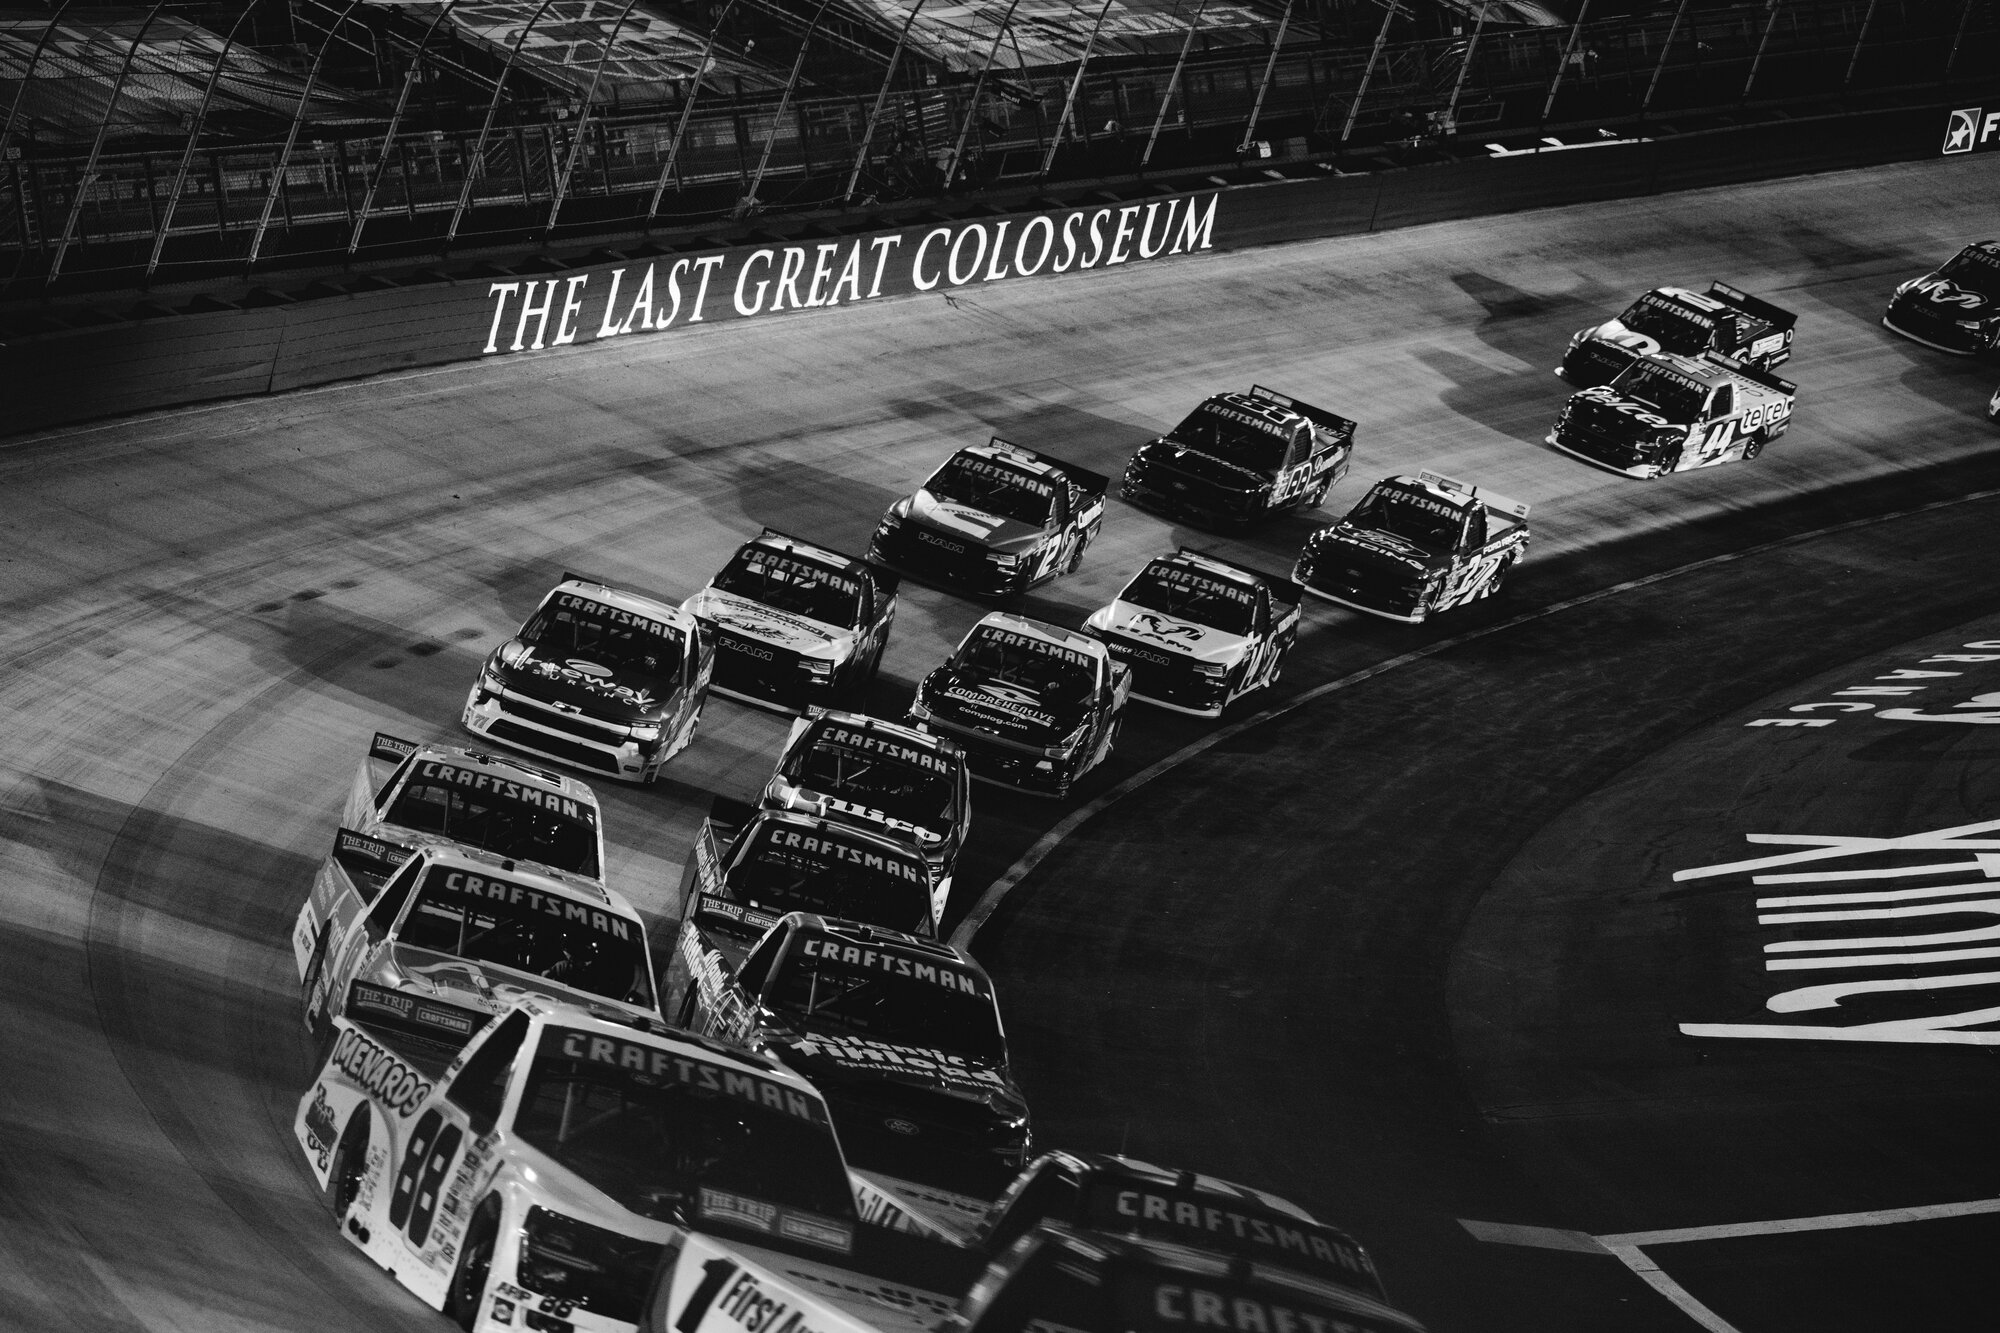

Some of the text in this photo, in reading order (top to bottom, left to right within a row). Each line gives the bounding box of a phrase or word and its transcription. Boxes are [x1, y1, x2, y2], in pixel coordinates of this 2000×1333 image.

[483, 193, 1220, 353] THE LAST GREAT COLOSSEUM
[1642, 294, 1714, 330] CRAFTSMAN
[1637, 361, 1708, 393] CRAFTSMAN
[1203, 403, 1283, 437] CRAFTSMAN
[1701, 421, 1736, 459] 44
[952, 457, 1048, 496] CRAFTSMAN
[1373, 486, 1462, 522] CRAFTSMAN
[918, 532, 965, 555] RAM
[741, 549, 856, 596] CRAFTSMAN
[1147, 566, 1250, 604] CRAFTSMAN
[558, 594, 676, 640] CRAFTSMAN
[718, 636, 774, 662] RAM
[981, 628, 1089, 668] CRAFTSMAN
[1134, 649, 1170, 666] AM
[501, 661, 649, 715] INSURANCE
[958, 706, 1029, 731] complog.com
[376, 735, 394, 748] THE
[821, 727, 948, 774] CRAFTSMAN
[422, 762, 579, 817] CRAFTSMAN
[342, 834, 386, 856] THE TRIP
[770, 829, 918, 884] CRAFTSMAN
[445, 871, 629, 941] CRAFTSMAN
[702, 897, 744, 916] THE TRIP
[803, 939, 978, 995] CRAFTSMAN
[355, 986, 383, 1004] THE
[383, 994, 414, 1012] TRIP
[421, 1013, 469, 1031] CRAFTSMAN
[790, 1041, 1004, 1086] Tiltload
[804, 1031, 967, 1068] Atlantic
[333, 1028, 433, 1118] MENARDS
[563, 1033, 811, 1121] CRAFTSMAN
[390, 1107, 463, 1249] 88
[1116, 1190, 1362, 1273] CRAFTSMAN
[719, 1272, 788, 1333] First
